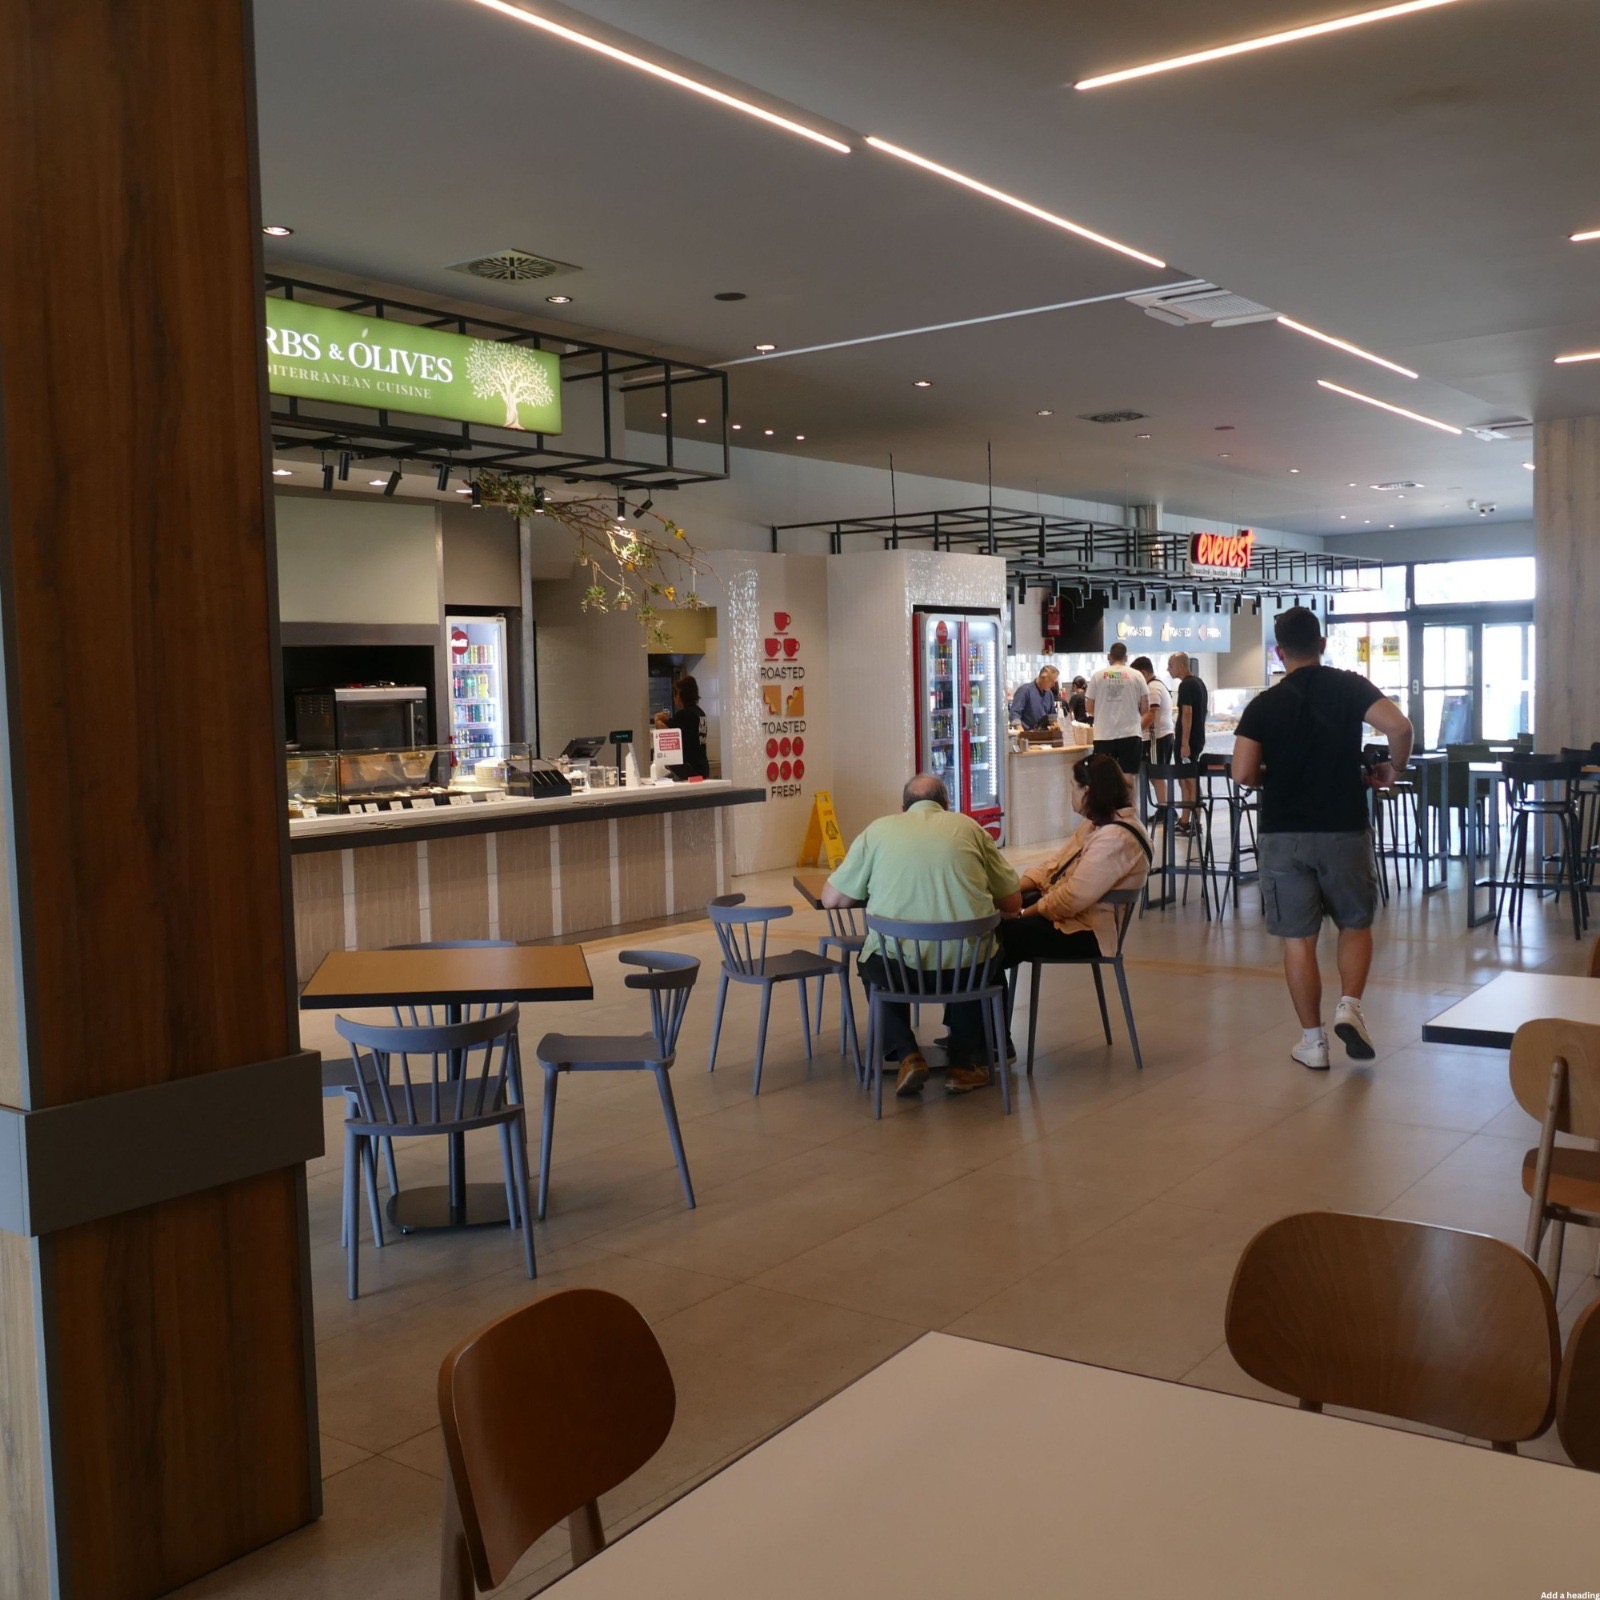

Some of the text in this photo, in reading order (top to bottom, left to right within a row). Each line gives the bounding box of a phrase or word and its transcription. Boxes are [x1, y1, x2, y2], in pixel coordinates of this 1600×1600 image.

[328, 343, 345, 361] &
[376, 381, 432, 399] CUISINE
[1197, 529, 1255, 568] everest
[760, 666, 805, 680] ROASTED
[762, 720, 807, 735] TOASTED
[771, 784, 802, 798] FRESH
